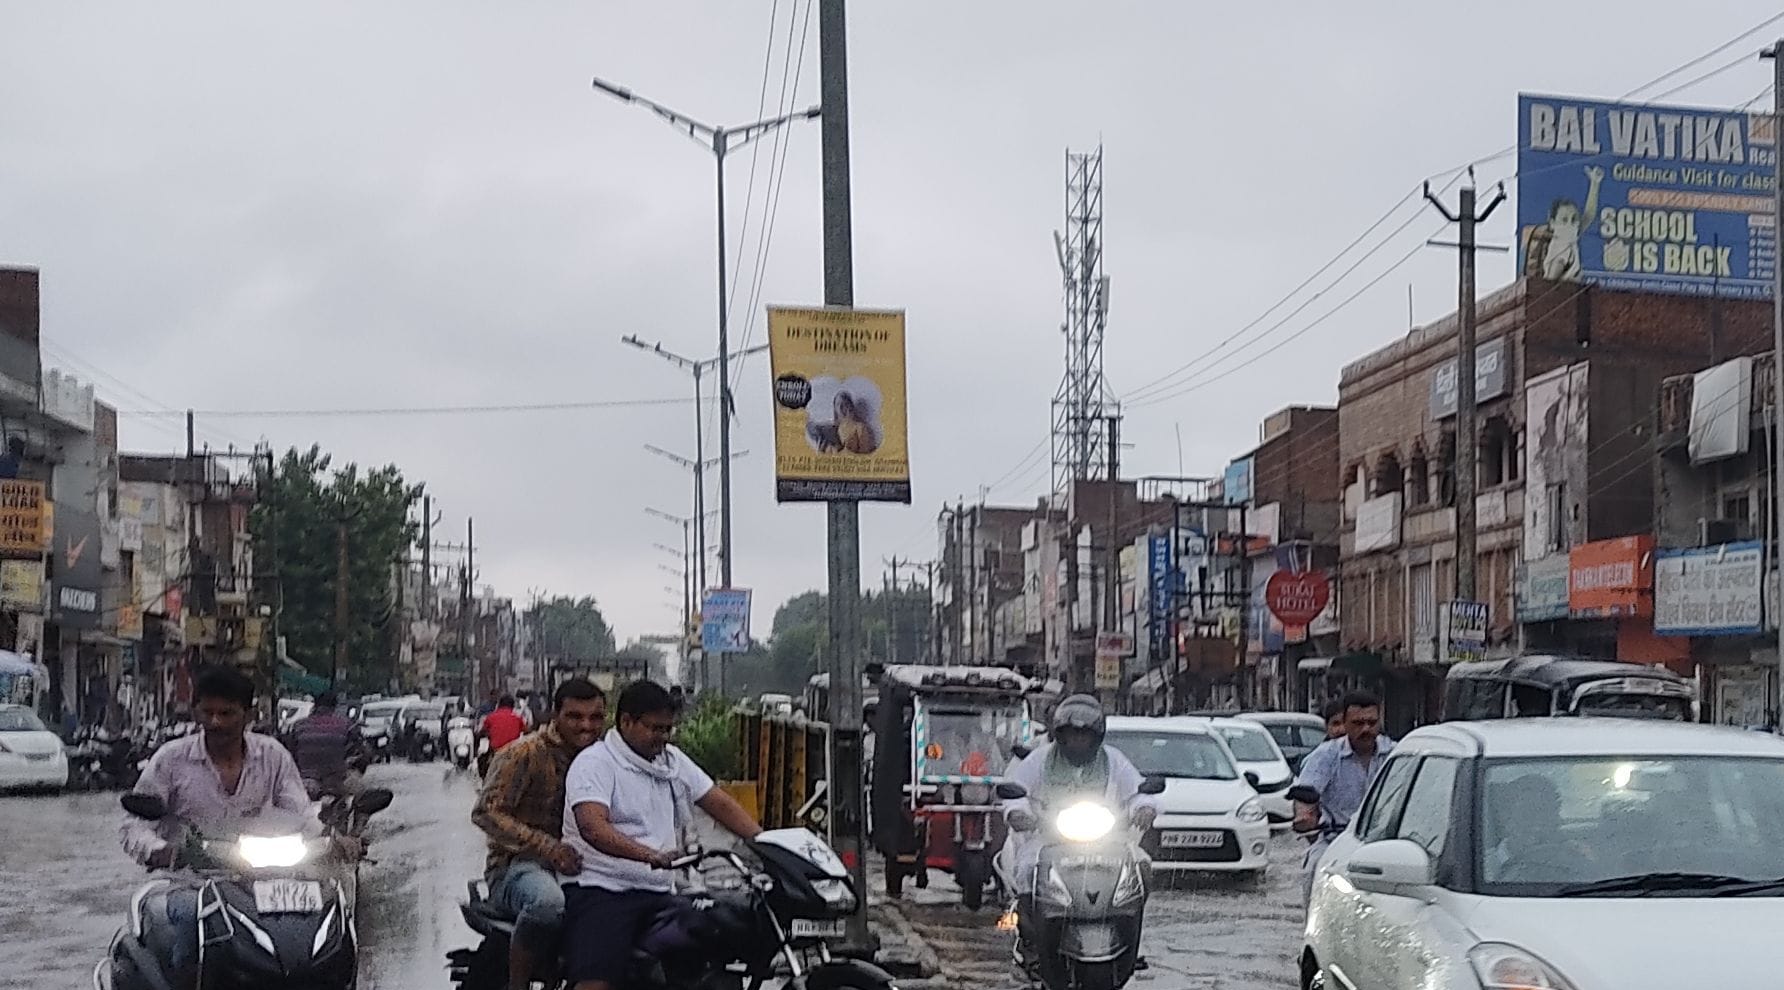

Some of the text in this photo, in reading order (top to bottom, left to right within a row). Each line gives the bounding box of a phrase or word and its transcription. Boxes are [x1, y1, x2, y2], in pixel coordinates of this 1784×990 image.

[1530, 102, 1745, 164] BAL VATIKA
[1613, 162, 1678, 185] Guidance
[1681, 167, 1713, 186] Visit
[1717, 169, 1738, 188] for
[1601, 206, 1698, 243] SCHOOL
[1633, 241, 1660, 272] IS
[1663, 242, 1733, 278] BACK
[787, 326, 891, 342] DESTINATION OF
[814, 340, 868, 354] DREAMS
[1276, 597, 1316, 611] HOTEL
